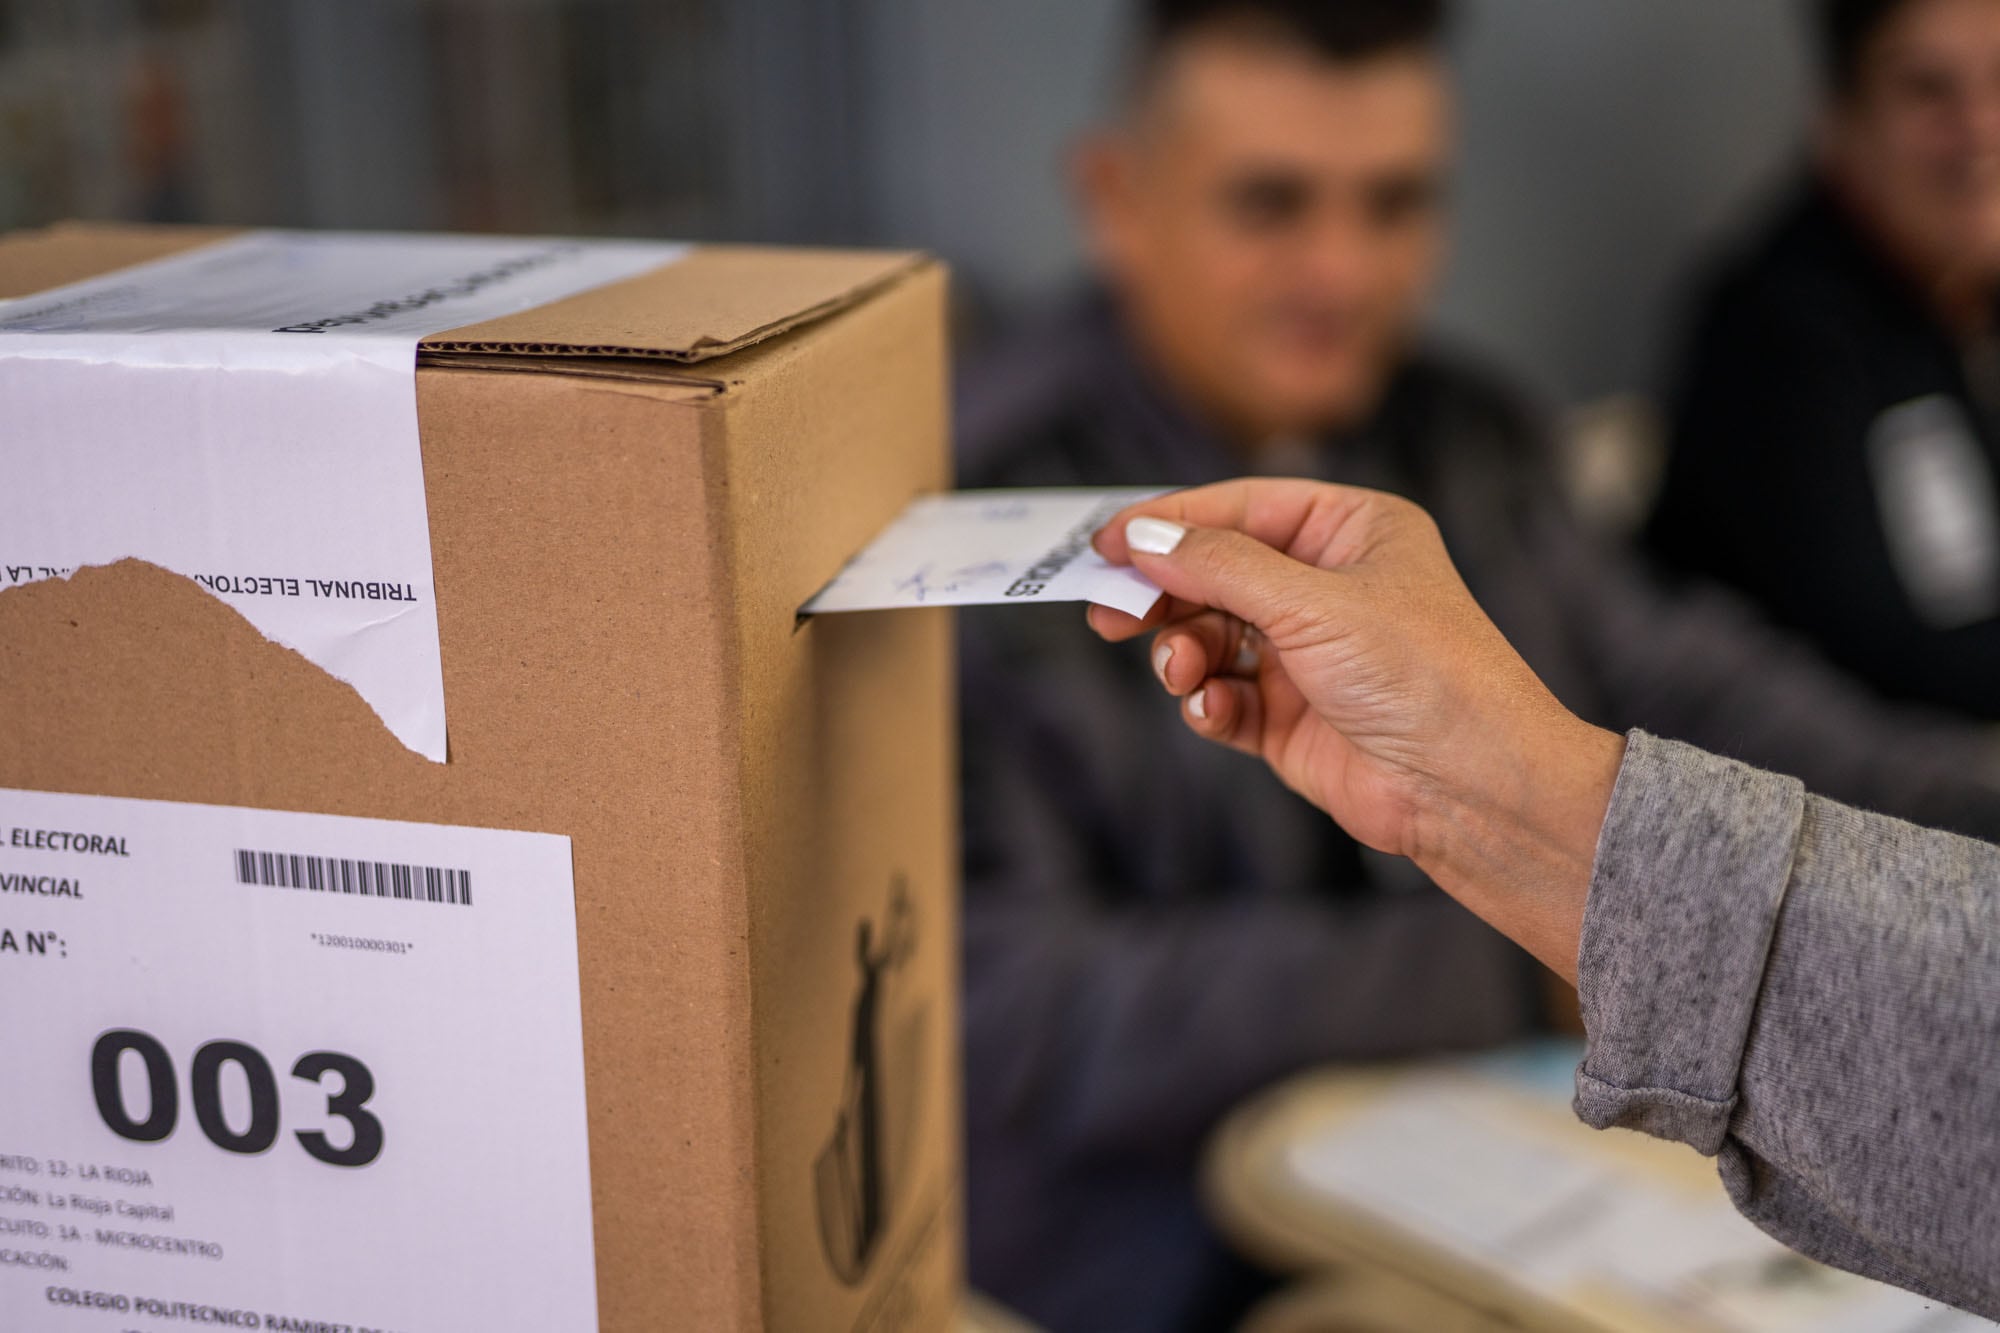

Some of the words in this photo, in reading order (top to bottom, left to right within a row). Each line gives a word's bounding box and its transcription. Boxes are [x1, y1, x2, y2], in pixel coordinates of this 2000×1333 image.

[194, 574, 300, 597] ELECTOR
[305, 579, 417, 602] TRIBUNAL
[11, 828, 130, 857] ELECTORAL
[91, 1027, 385, 1168] 003
[78, 1163, 99, 1180] LA
[103, 1166, 153, 1188] RIOJA
[48, 1192, 67, 1209] La
[70, 1194, 113, 1217] Rioja
[116, 1199, 175, 1222] Capital
[95, 1229, 224, 1261] MICROCENTRO
[45, 1285, 130, 1314] COLEGIO
[133, 1297, 261, 1329] POLITECNICO
